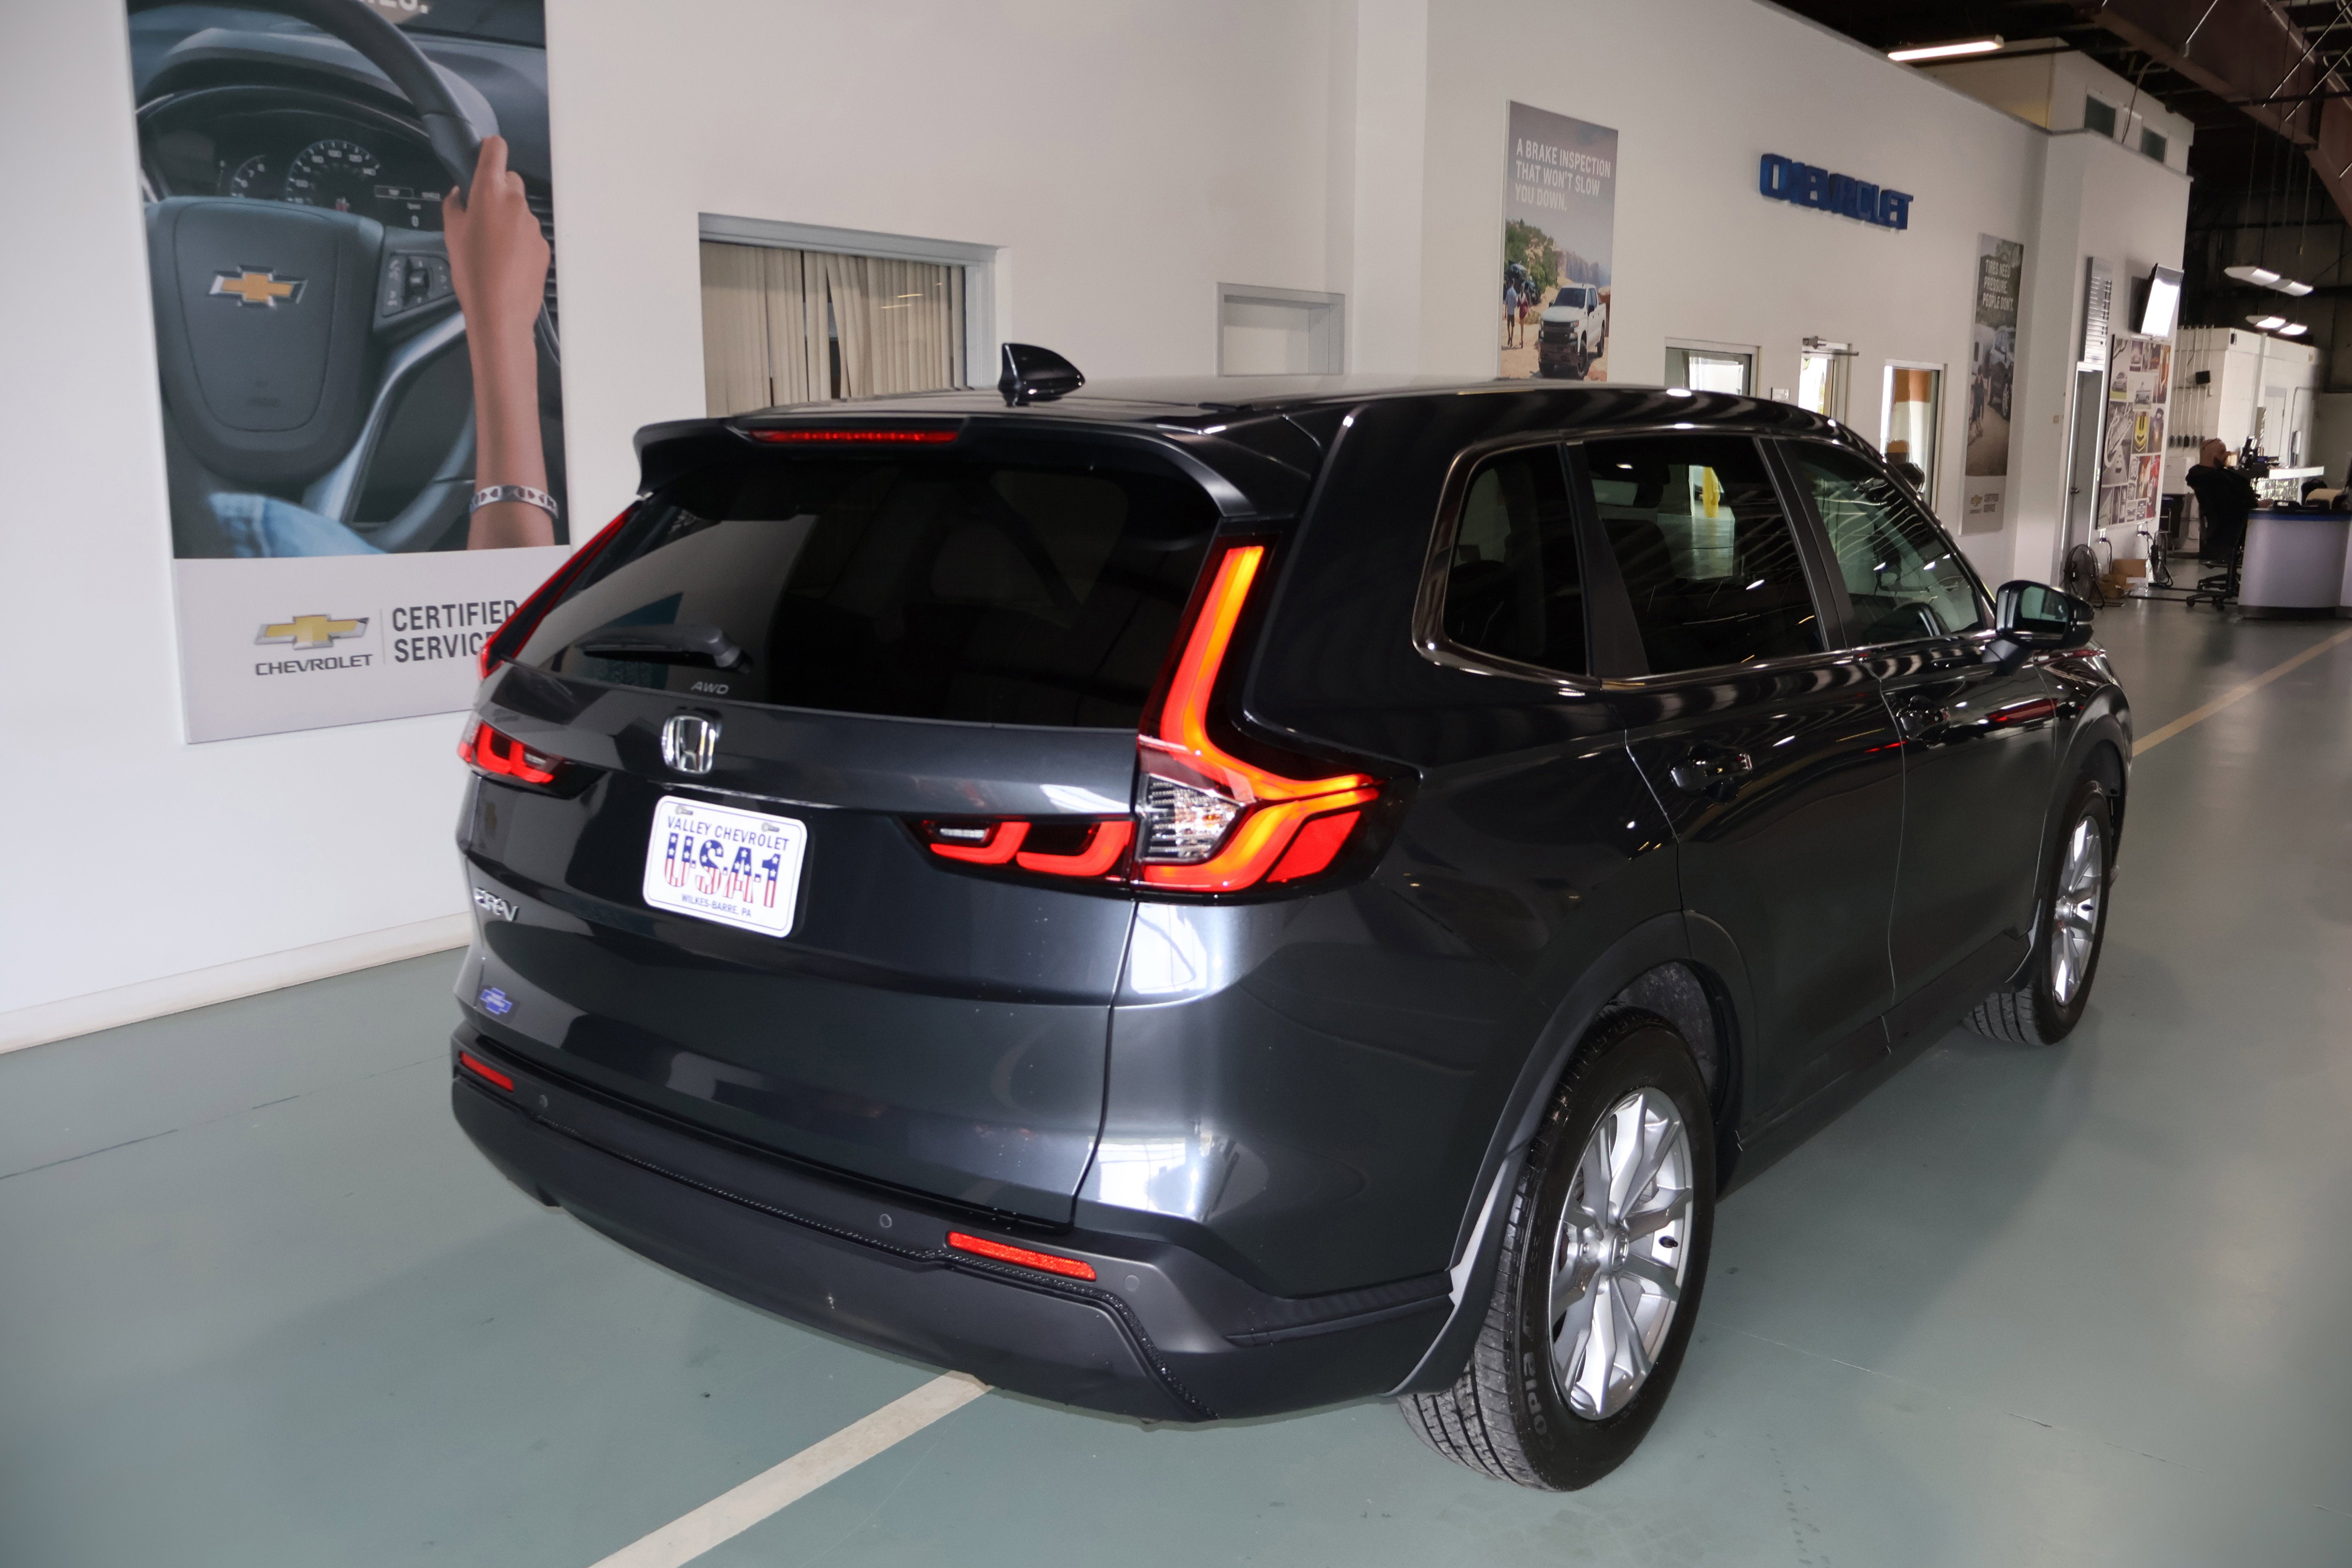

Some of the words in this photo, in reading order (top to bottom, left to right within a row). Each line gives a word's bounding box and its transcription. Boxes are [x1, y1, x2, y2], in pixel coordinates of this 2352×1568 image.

[1516, 138, 1523, 157] A
[1526, 140, 1557, 165] BRAKE
[1560, 149, 1610, 178] INSPECTION
[1516, 160, 1541, 183] THAT
[1544, 167, 1573, 190] WON'T
[1575, 175, 1600, 197] SLOW
[1515, 183, 1534, 204] YOU
[1537, 188, 1567, 212] DOWN.
[1986, 259, 1999, 275] TIRES
[1999, 263, 2011, 278] NEED
[1982, 292, 2000, 310] PEOPLE
[256, 654, 373, 675] CHEVROLET
[690, 682, 729, 694] AWD
[668, 816, 711, 835] VALLEY
[715, 826, 789, 851] CHEVROLET
[742, 907, 752, 918] PA
